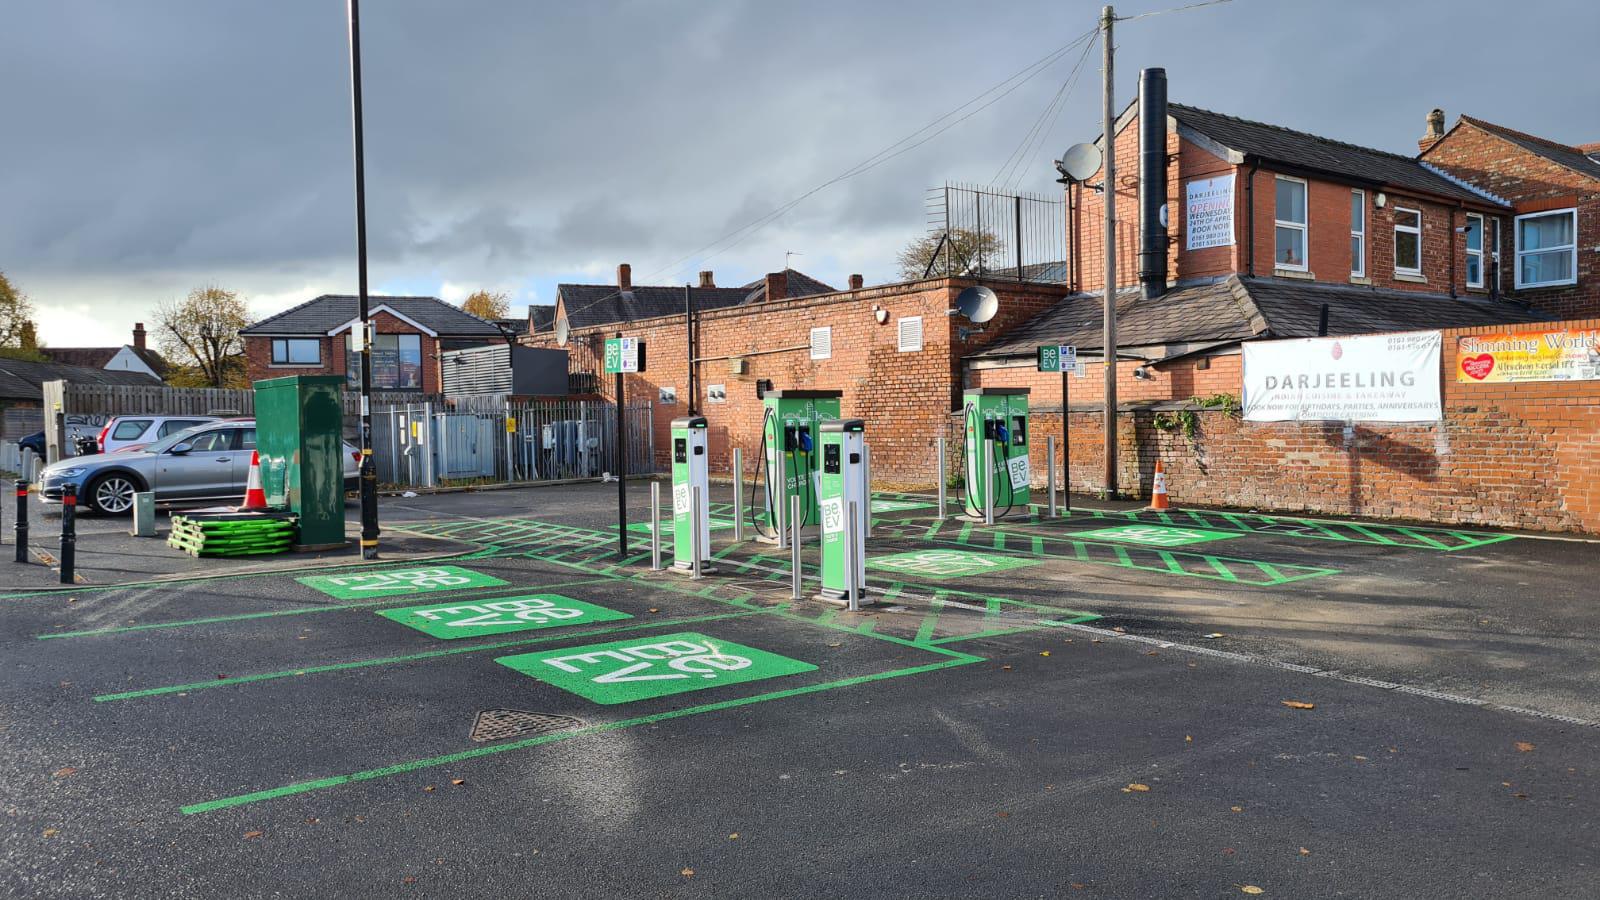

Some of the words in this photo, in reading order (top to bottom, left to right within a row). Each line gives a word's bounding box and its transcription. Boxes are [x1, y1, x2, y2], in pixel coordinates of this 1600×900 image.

[1192, 225, 1211, 234] BOOK
[1460, 337, 1538, 354] Slimming
[1544, 331, 1597, 350] World
[1043, 359, 1056, 369] EV
[1265, 371, 1415, 390] DARJEELING
[1356, 391, 1407, 400] TAKEAWAY
[1013, 471, 1027, 485] EV
[825, 515, 840, 528] EV
